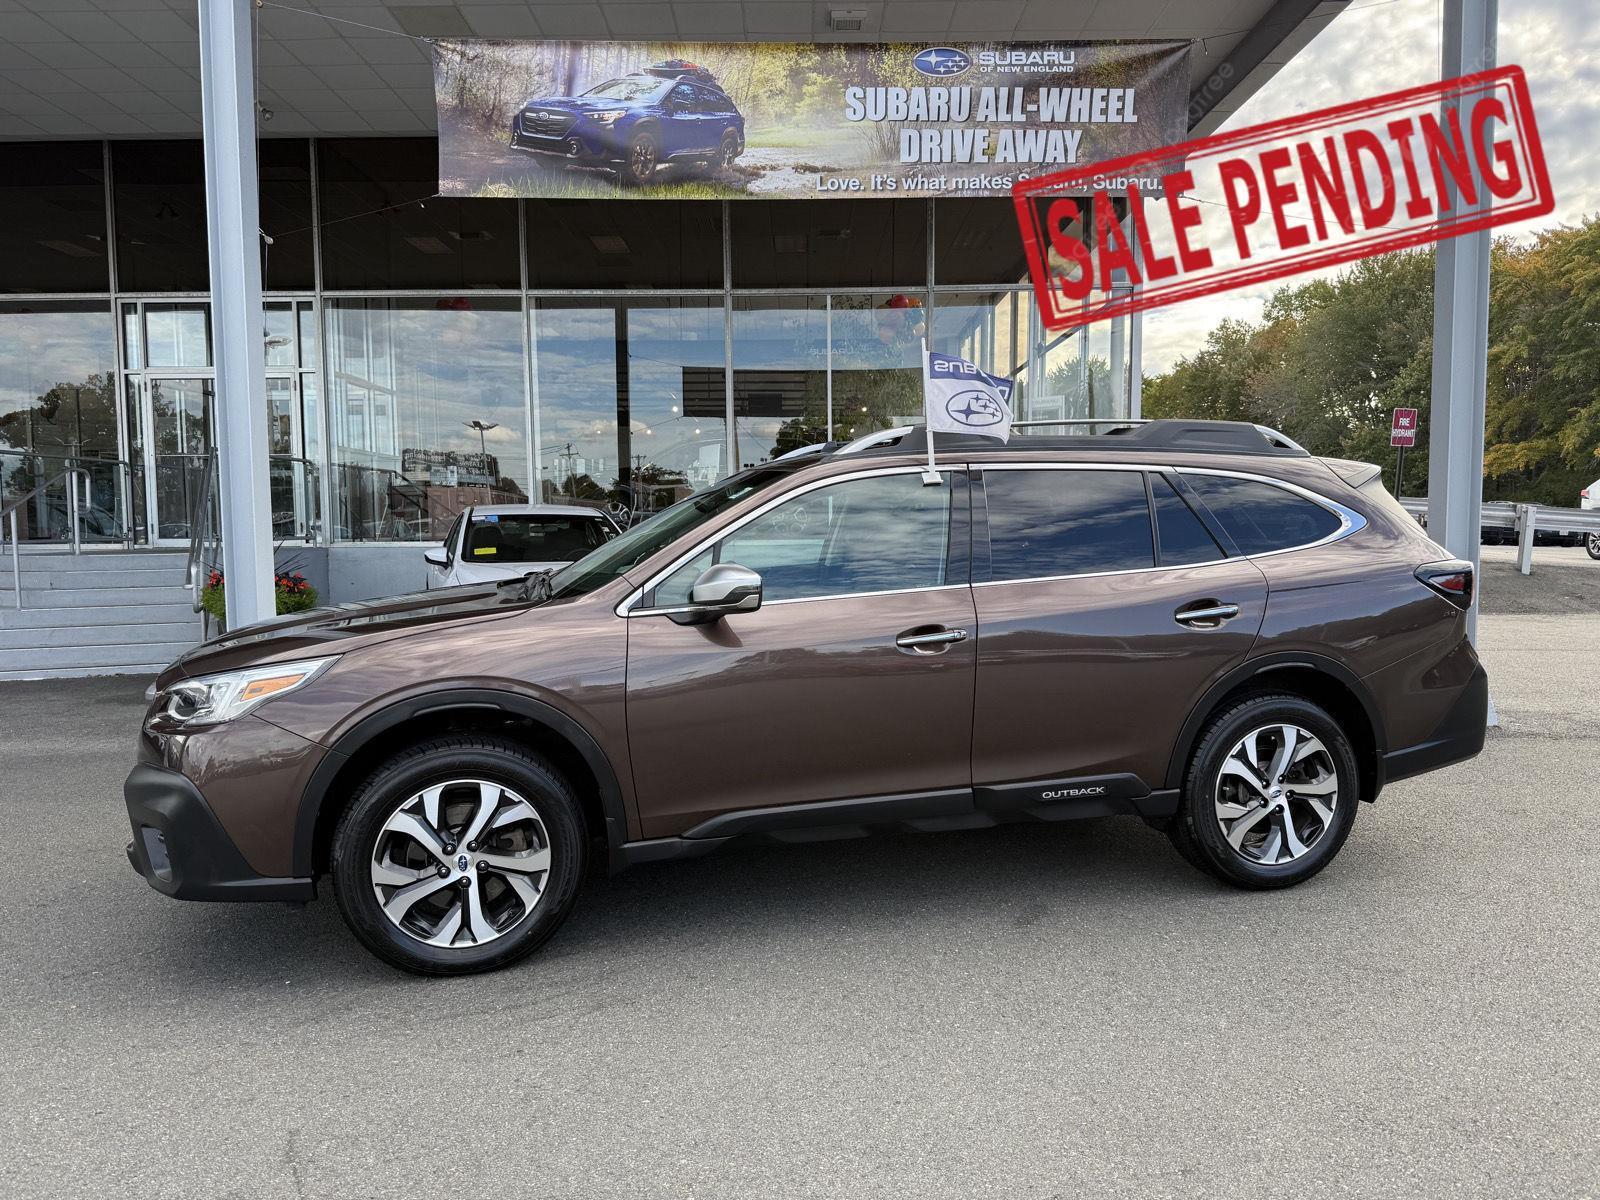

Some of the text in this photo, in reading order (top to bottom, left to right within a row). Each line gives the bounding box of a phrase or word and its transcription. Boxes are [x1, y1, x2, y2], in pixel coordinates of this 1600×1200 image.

[979, 51, 1075, 65] SUBARU
[845, 86, 1138, 123] SUBARU ALL-WHEEL
[900, 128, 1083, 164] DRIVE AWAY
[816, 174, 865, 191] Love.
[871, 173, 897, 190] It's
[902, 173, 947, 190] what
[952, 173, 1013, 190] makes
[1017, 172, 1087, 192] Saru,
[1042, 786, 1104, 799] OUTBACK
